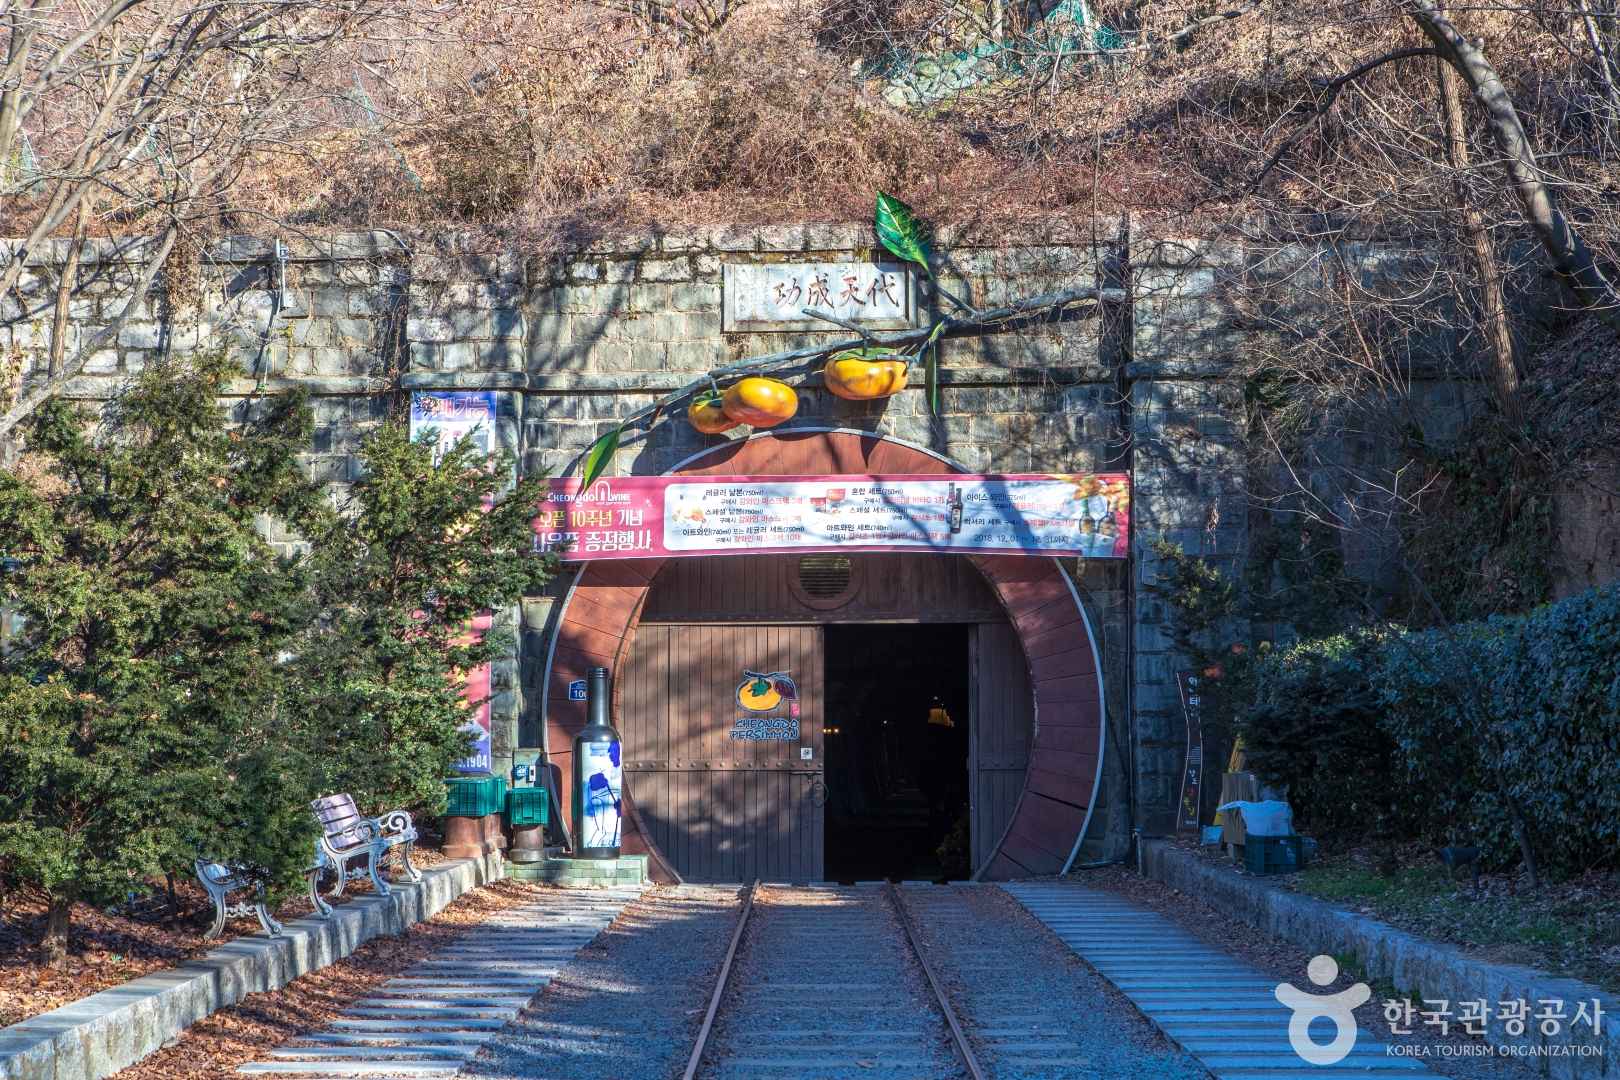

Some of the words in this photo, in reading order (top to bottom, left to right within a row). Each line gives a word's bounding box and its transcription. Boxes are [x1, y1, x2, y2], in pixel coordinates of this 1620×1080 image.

[966, 494, 989, 502] 아이스
[571, 509, 612, 528] 10주년
[617, 509, 643, 526] 기념
[736, 719, 799, 729] CHEONGDO
